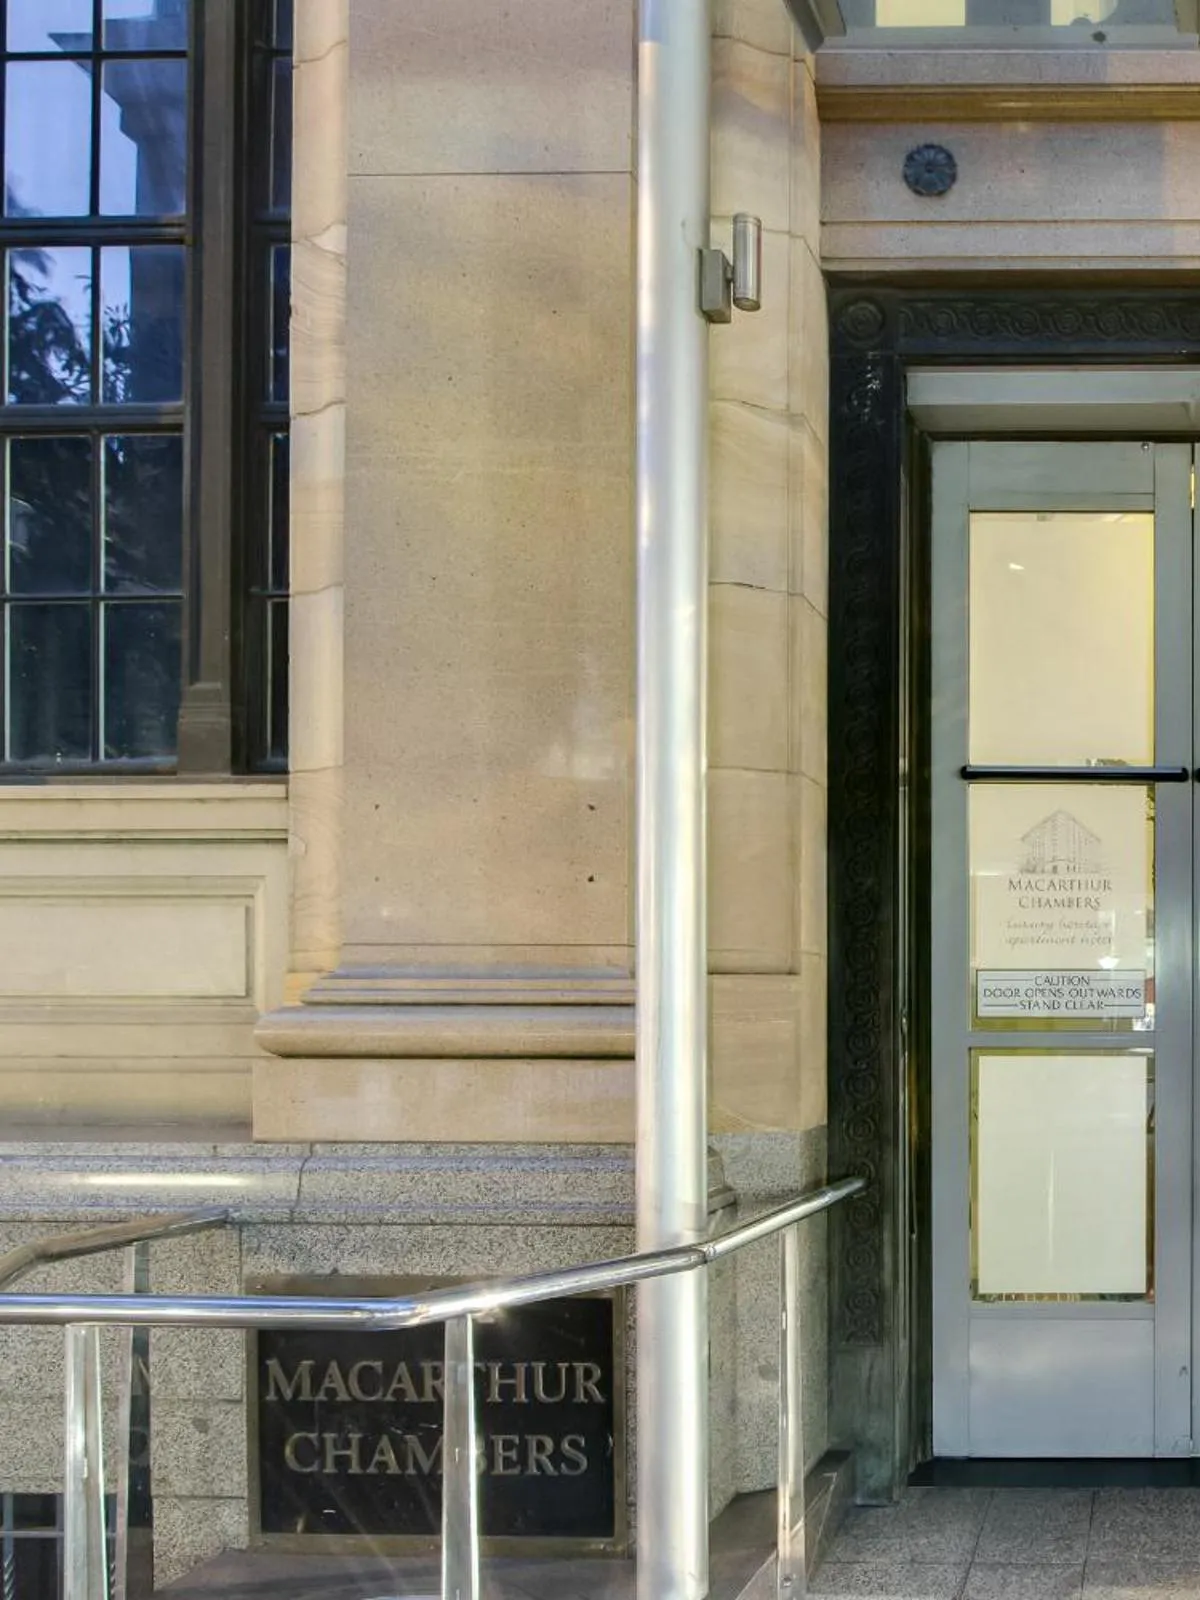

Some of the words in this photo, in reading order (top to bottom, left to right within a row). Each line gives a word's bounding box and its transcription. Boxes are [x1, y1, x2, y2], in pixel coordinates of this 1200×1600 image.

[1008, 878, 1113, 892] MACARTHUR
[1018, 896, 1101, 910] CHAMBERS
[1034, 975, 1090, 986] CAUTION
[983, 988, 1020, 998] DOOR
[1024, 988, 1065, 998] OPENS
[1068, 988, 1142, 999] OUTWARDS
[1019, 1000, 1061, 1010] STAND
[1064, 1000, 1105, 1010] CLEAR
